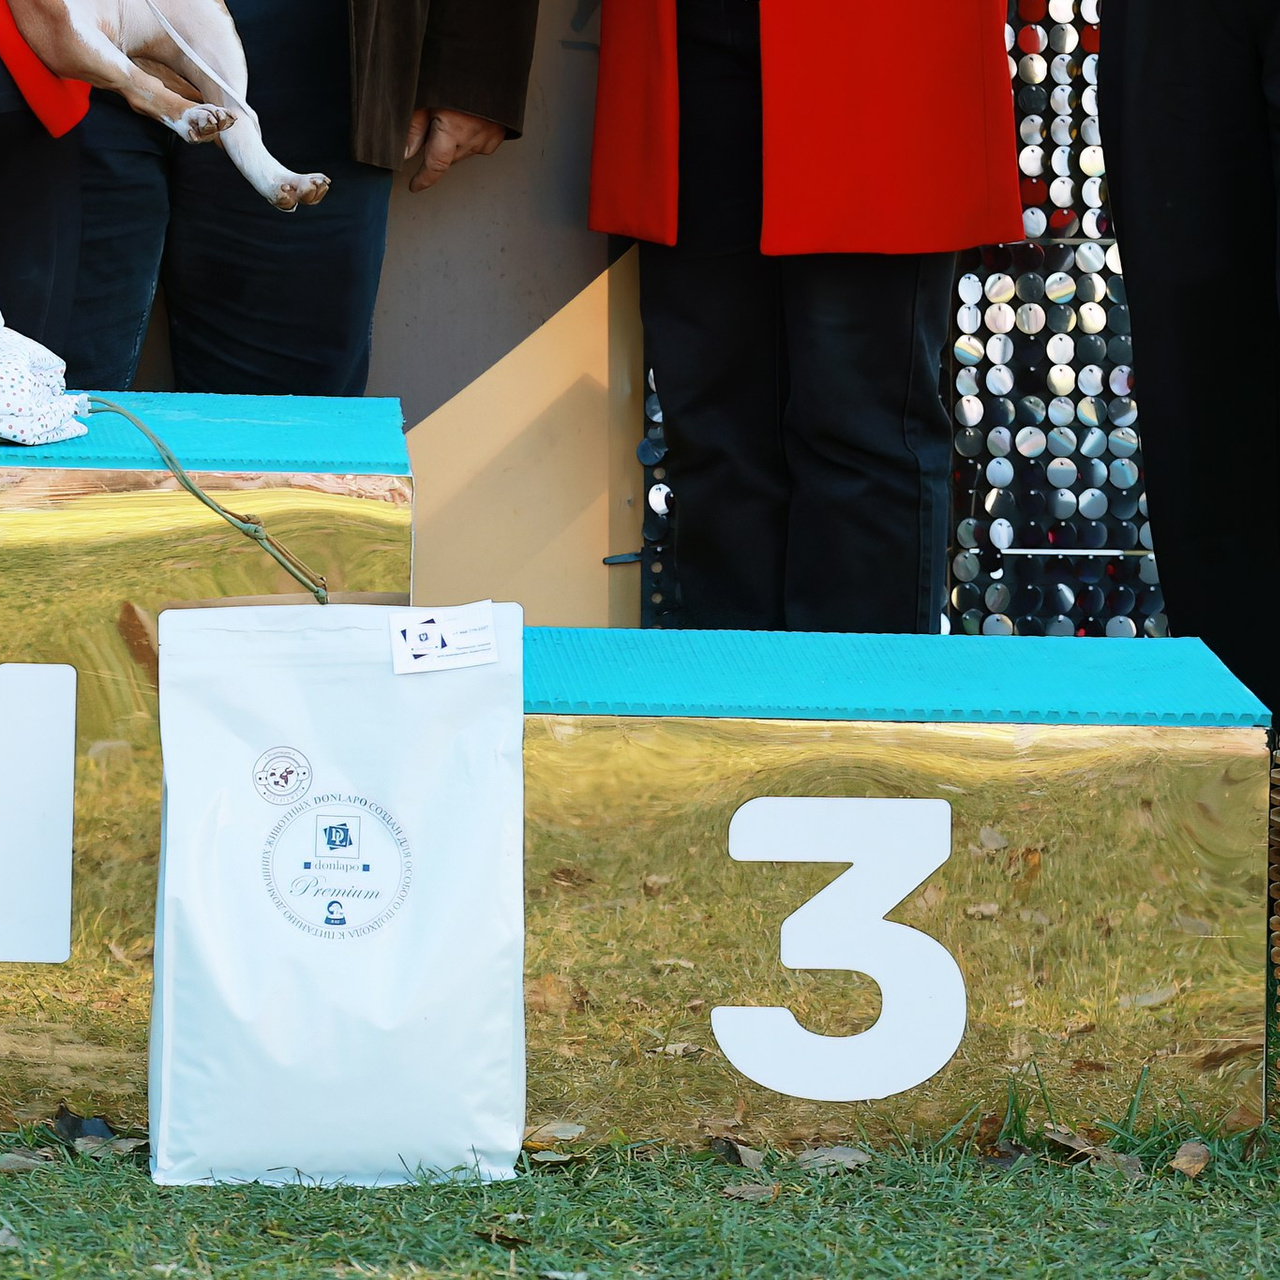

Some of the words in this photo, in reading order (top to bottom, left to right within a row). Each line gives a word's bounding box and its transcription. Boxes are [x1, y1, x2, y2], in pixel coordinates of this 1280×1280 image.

[314, 793, 368, 807] DONLAPO
[265, 799, 312, 849] ЖИВОТНЫХ
[369, 802, 403, 836] СОЗДАН
[397, 837, 411, 858] ДЛЯ
[261, 849, 287, 910] ДОМАШНИХ
[314, 859, 360, 873] donlapo
[289, 874, 381, 900] Premium
[393, 860, 413, 910] ОСОБОГО
[337, 931, 346, 940] К
[348, 909, 396, 939] ПОДХОДА
[710, 796, 967, 1102] 3
